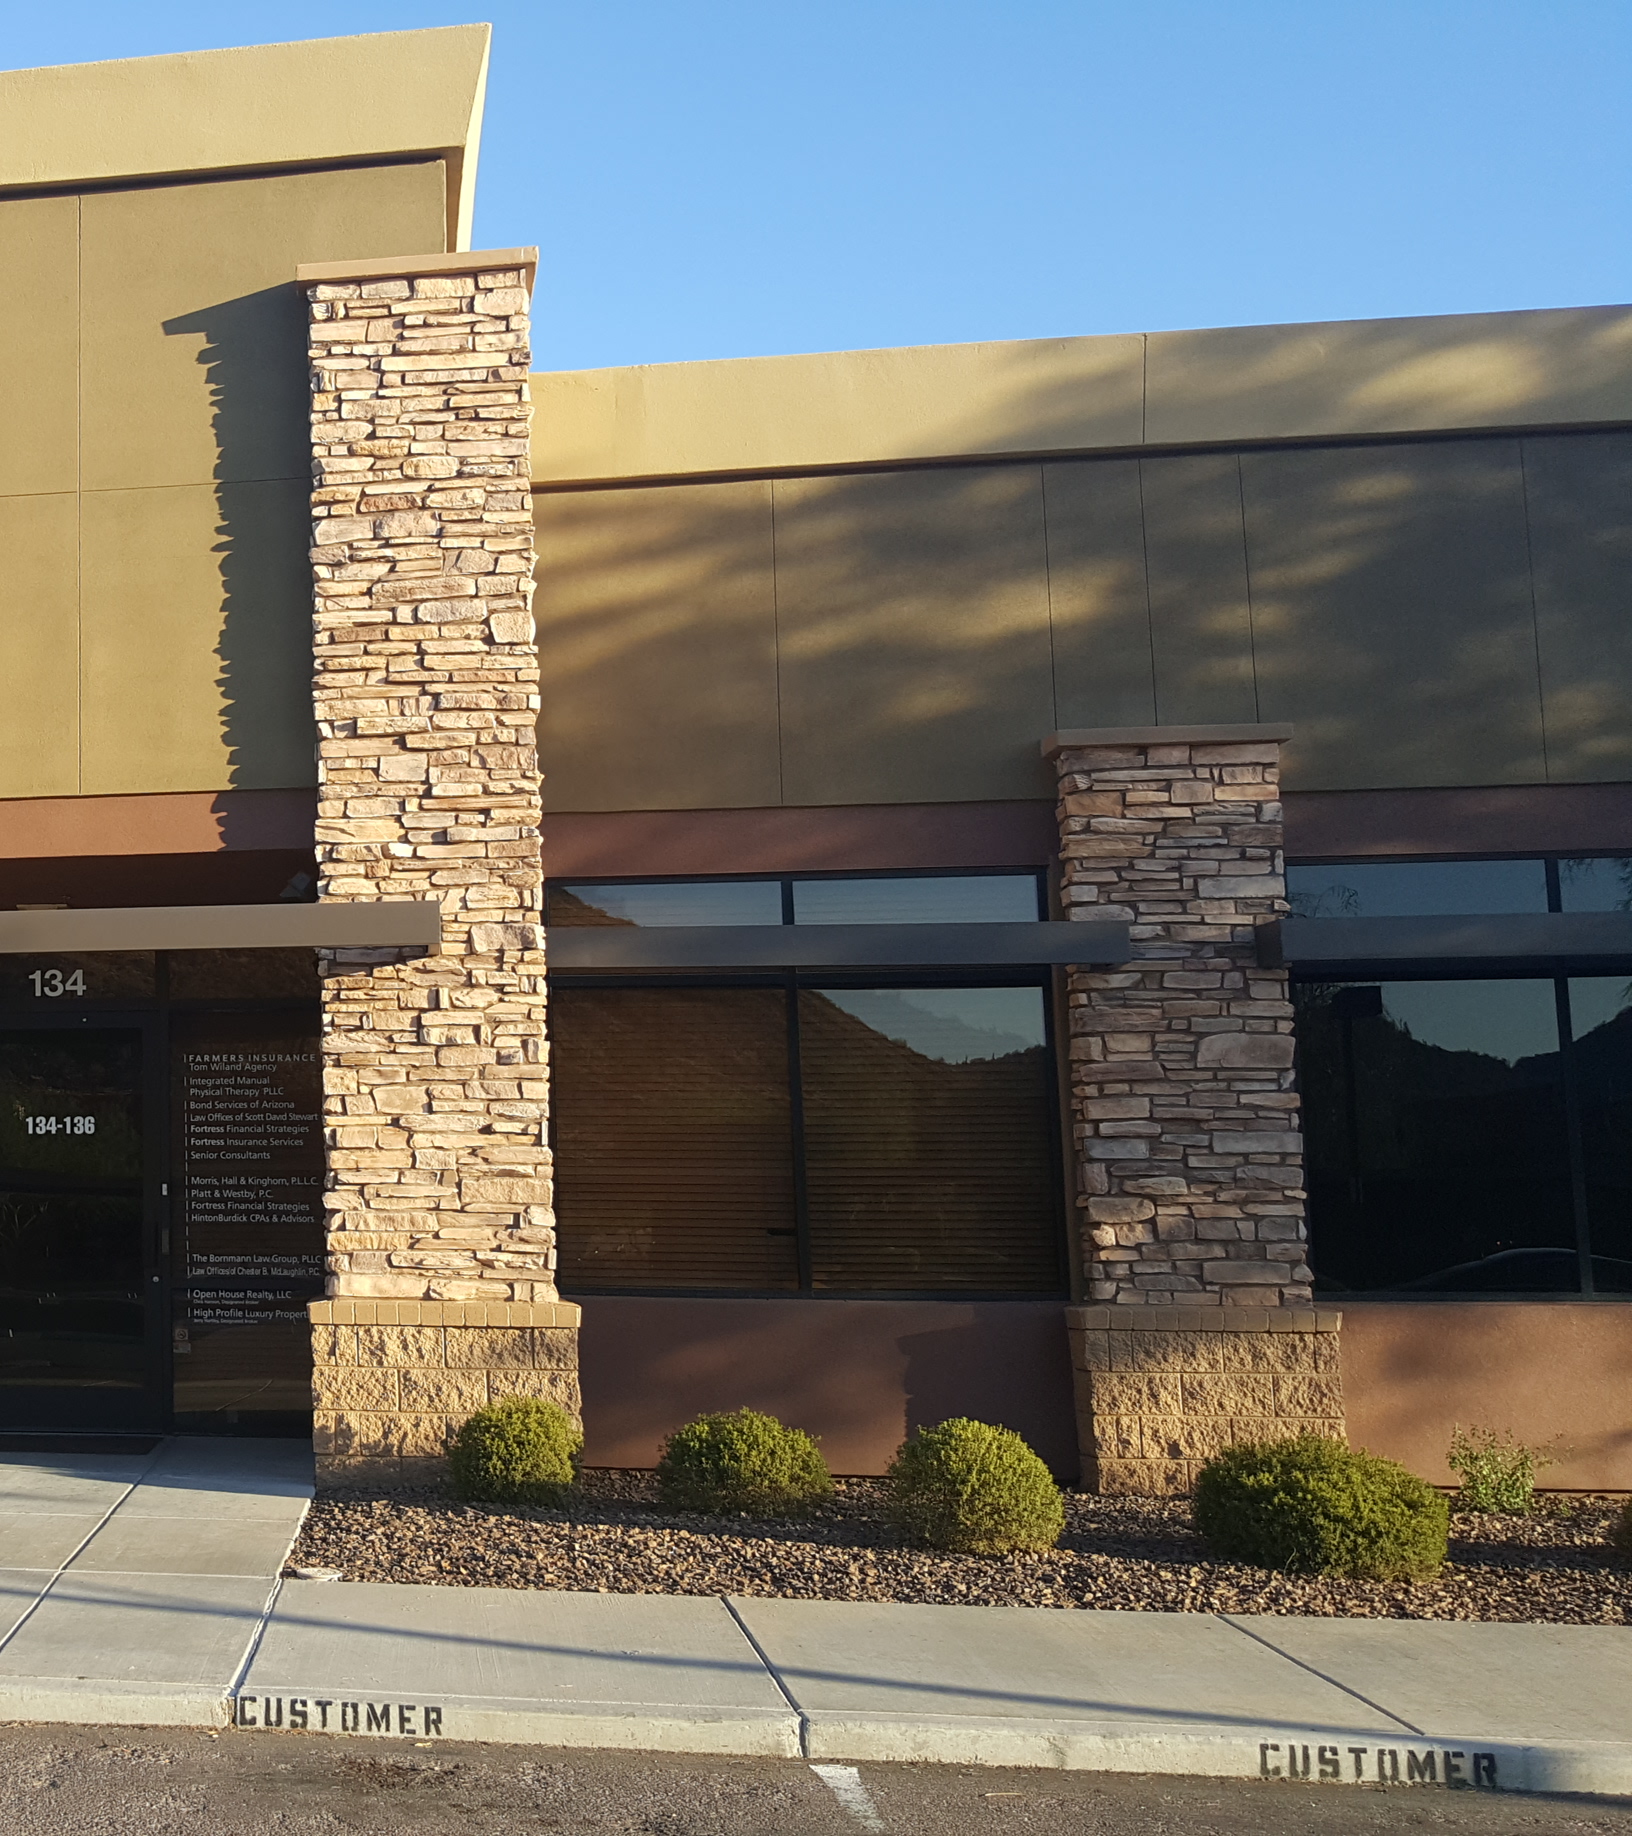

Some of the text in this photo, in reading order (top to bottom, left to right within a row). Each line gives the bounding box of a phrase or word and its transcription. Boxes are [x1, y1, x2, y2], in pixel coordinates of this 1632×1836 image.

[28, 969, 87, 997] 134
[189, 1054, 316, 1062] FARMERS INSURANCE
[189, 1063, 277, 1072] Tom Wiland Agency
[189, 1076, 270, 1086] Integrated Manual
[190, 1087, 284, 1097] Physical Therapy PLLC
[190, 1100, 295, 1109] Bond Services of Arizona
[190, 1113, 206, 1121] Law
[208, 1113, 233, 1121] Offices
[235, 1113, 244, 1121] of
[25, 1116, 95, 1134] 134-136
[190, 1124, 309, 1134] Fortress Financial Strategies
[190, 1137, 304, 1146] Fortress Insurance Services
[190, 1151, 271, 1159] Senior Consultants
[191, 1177, 219, 1186] Morris,
[221, 1176, 237, 1185] Hall
[239, 1176, 247, 1185] &
[191, 1190, 212, 1198] Platt
[214, 1190, 221, 1198] &
[259, 1190, 274, 1198] P.C.
[191, 1201, 310, 1212] Fortress Financial Strategies
[191, 1213, 315, 1222] HintonBurdick CPAs & Advisors
[192, 1254, 207, 1262] The
[253, 1254, 270, 1263] Law
[301, 1255, 322, 1263] PLLC
[192, 1267, 205, 1275] Law
[206, 1266, 229, 1275] Offices
[237, 1267, 261, 1275] Chester
[193, 1289, 217, 1299] Open
[218, 1290, 245, 1299] House
[246, 1290, 275, 1300] Realty,
[193, 1308, 214, 1318] High
[215, 1308, 243, 1317] Profile
[245, 1309, 274, 1319] Luxury
[236, 1695, 443, 1736] CUSTOMER
[1258, 1743, 1498, 1786] CUSTOMER
